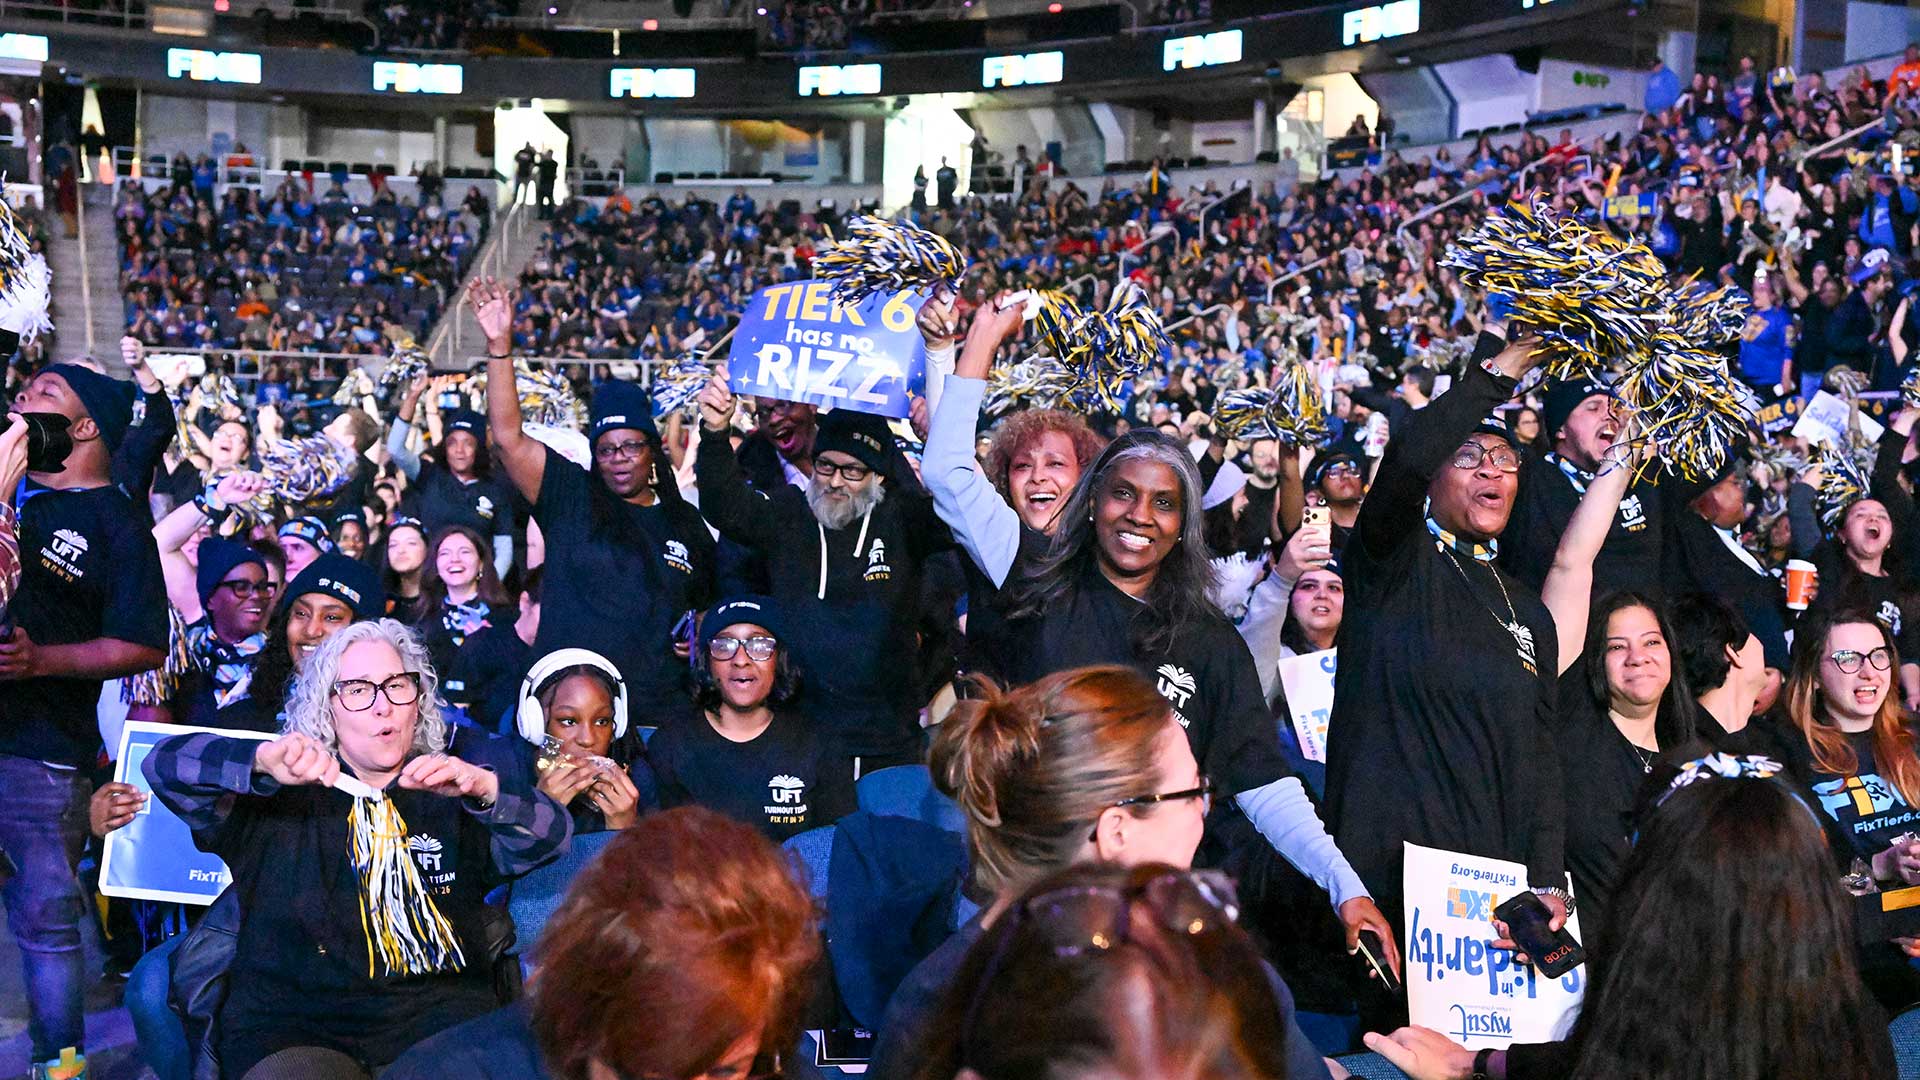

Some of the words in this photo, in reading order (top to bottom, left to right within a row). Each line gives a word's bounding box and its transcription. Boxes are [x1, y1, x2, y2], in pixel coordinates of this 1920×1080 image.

[762, 283, 867, 327] TIER
[881, 289, 915, 333] 6
[785, 321, 833, 348] has
[839, 332, 875, 353] no
[755, 342, 892, 405] RIZZ
[52, 537, 83, 562] UFT
[65, 562, 84, 578] TEAM
[1156, 676, 1192, 709] UFT
[771, 788, 803, 804] UFT
[763, 805, 794, 814] TURNOUT
[770, 815, 782, 823] FIX
[434, 871, 456, 884] TEAM
[1450, 863, 1517, 887] FixTier6.org
[1409, 906, 1582, 999] Slidarity
[1544, 944, 1574, 965] 12:08
[1501, 982, 1514, 998] in
[1449, 1003, 1513, 1043] nysut
